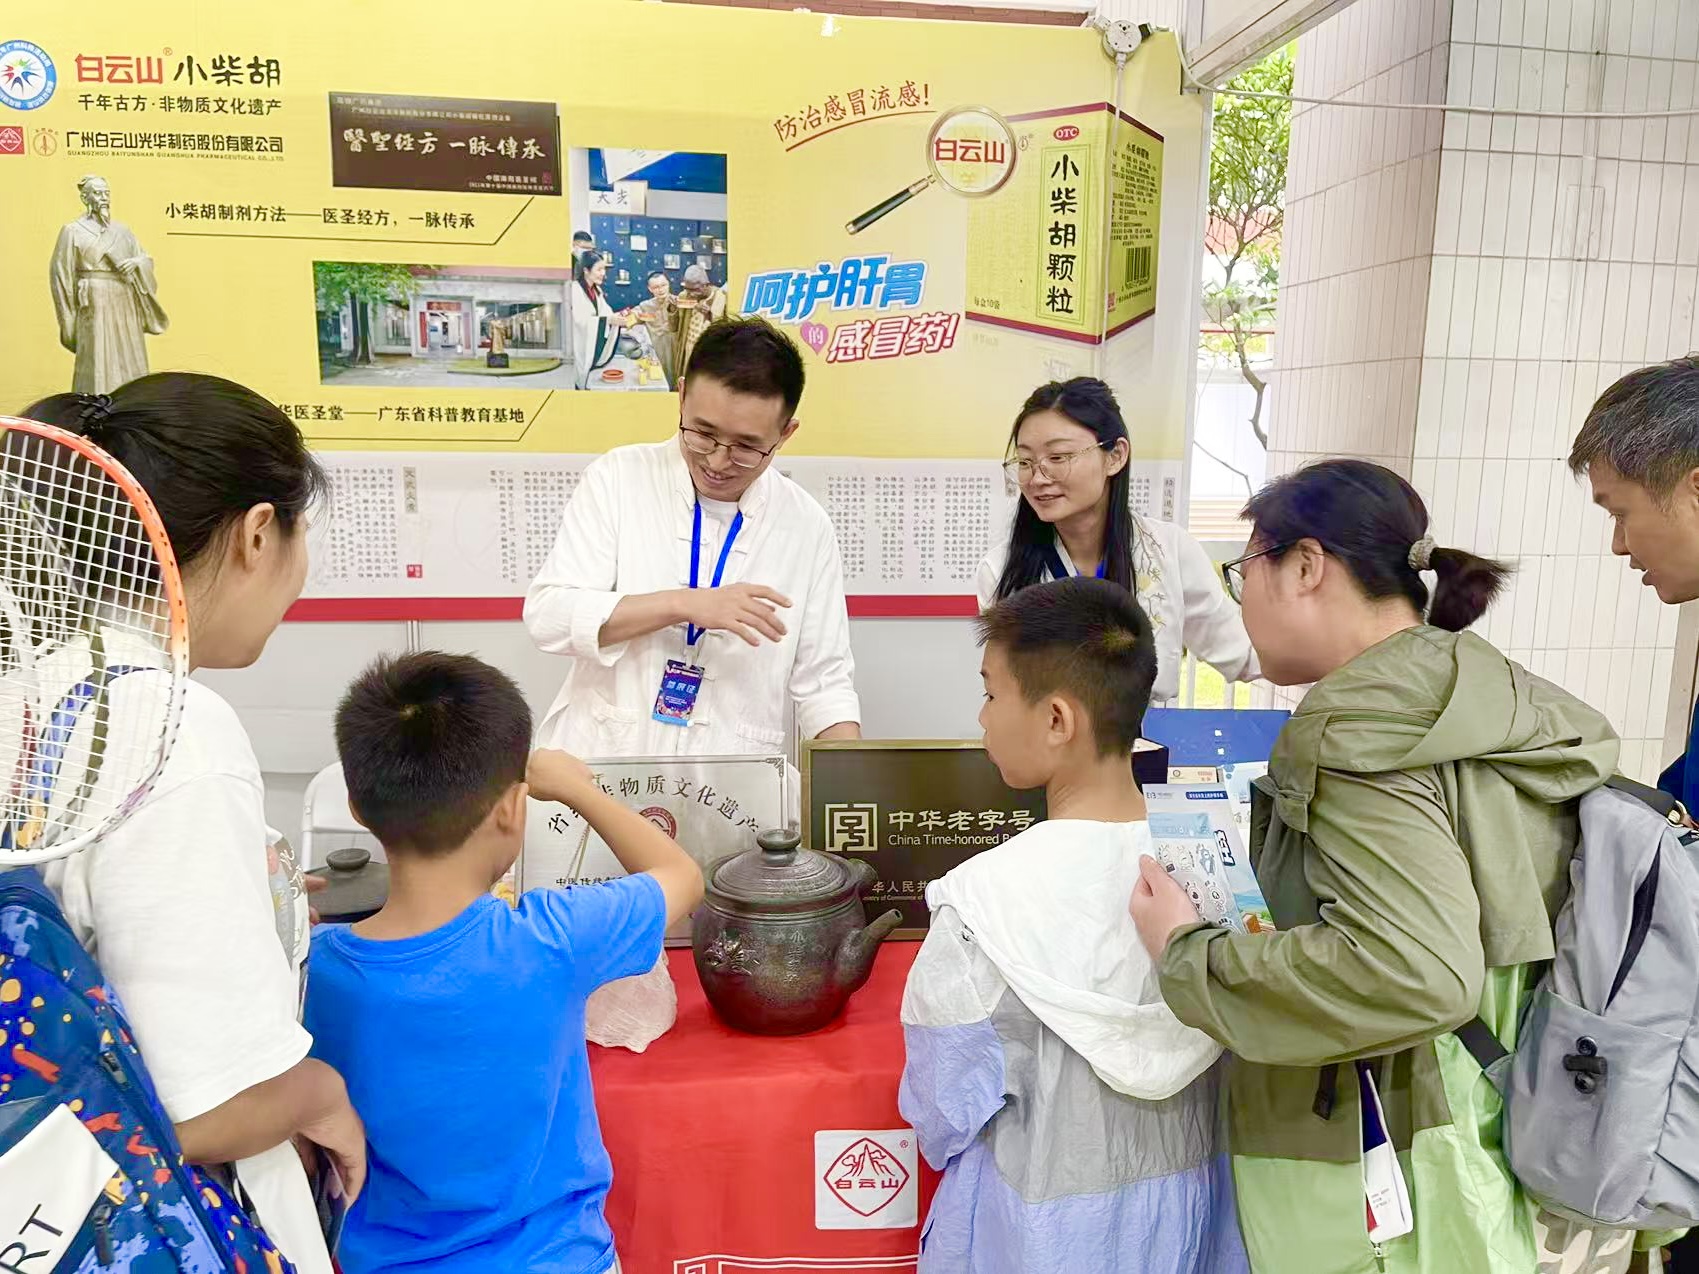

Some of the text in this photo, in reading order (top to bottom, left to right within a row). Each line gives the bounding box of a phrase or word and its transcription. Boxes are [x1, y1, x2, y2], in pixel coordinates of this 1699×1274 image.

[75, 53, 164, 84] 白云山
[173, 54, 281, 88] 小柴胡
[66, 131, 284, 153] 广州白云山光华制药股份有限公司
[1055, 127, 1079, 139] OTC
[934, 137, 1005, 164] 白云山
[1045, 154, 1080, 315] 小柴胡颗粒
[744, 256, 926, 320] 呵护肝胃
[888, 808, 1036, 832] 中华老字号
[888, 834, 921, 845] China
[923, 834, 999, 845] Time-honored
[834, 1178, 899, 1189] 白云山
